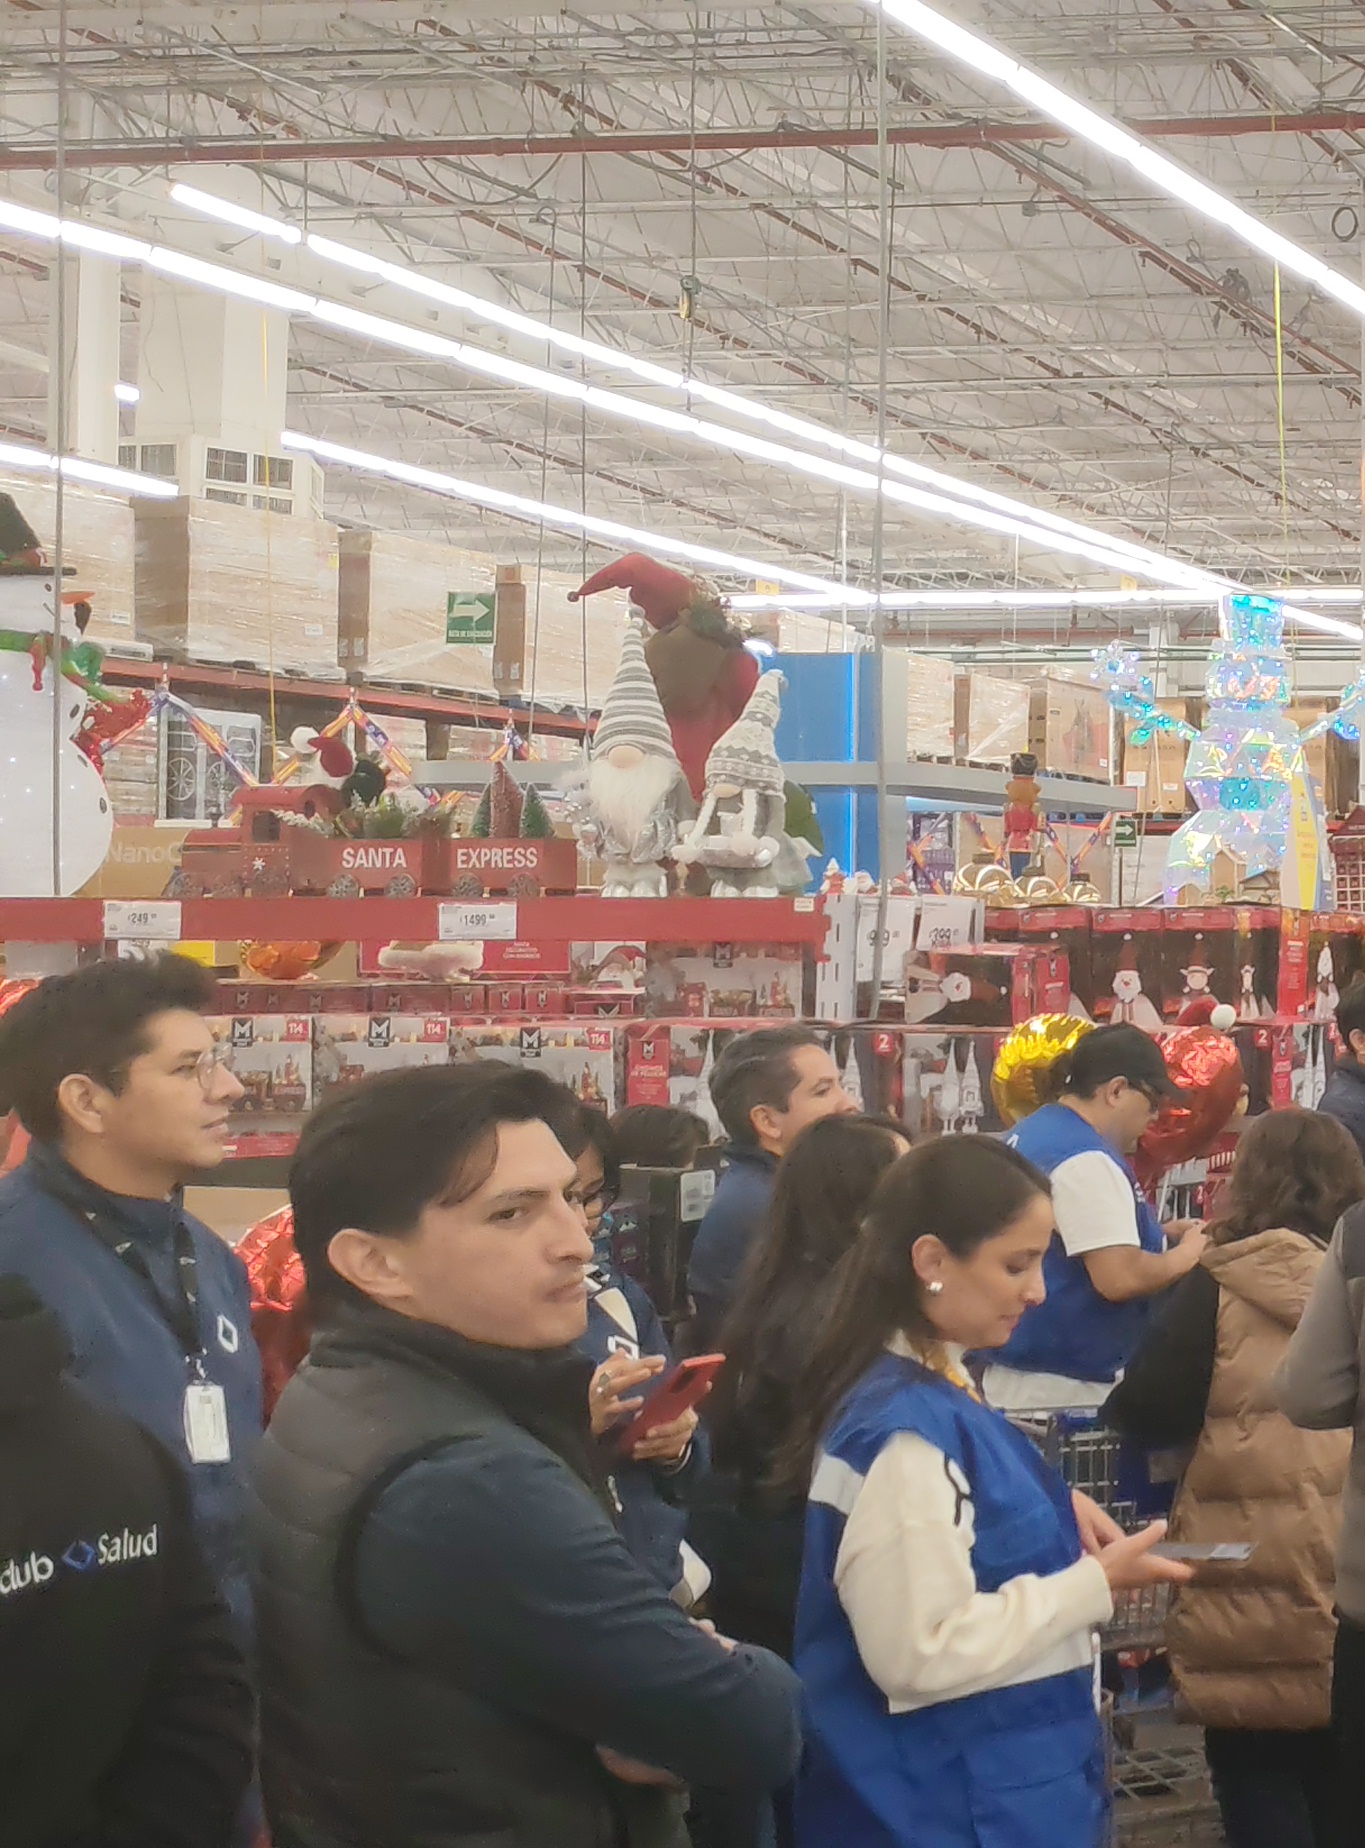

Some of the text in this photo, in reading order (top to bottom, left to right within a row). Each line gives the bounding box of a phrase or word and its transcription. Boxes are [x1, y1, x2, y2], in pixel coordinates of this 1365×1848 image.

[341, 847, 539, 869] SANTA EXPRESS
[879, 1036, 889, 1050] 2
[98, 1523, 158, 1566] Salud
